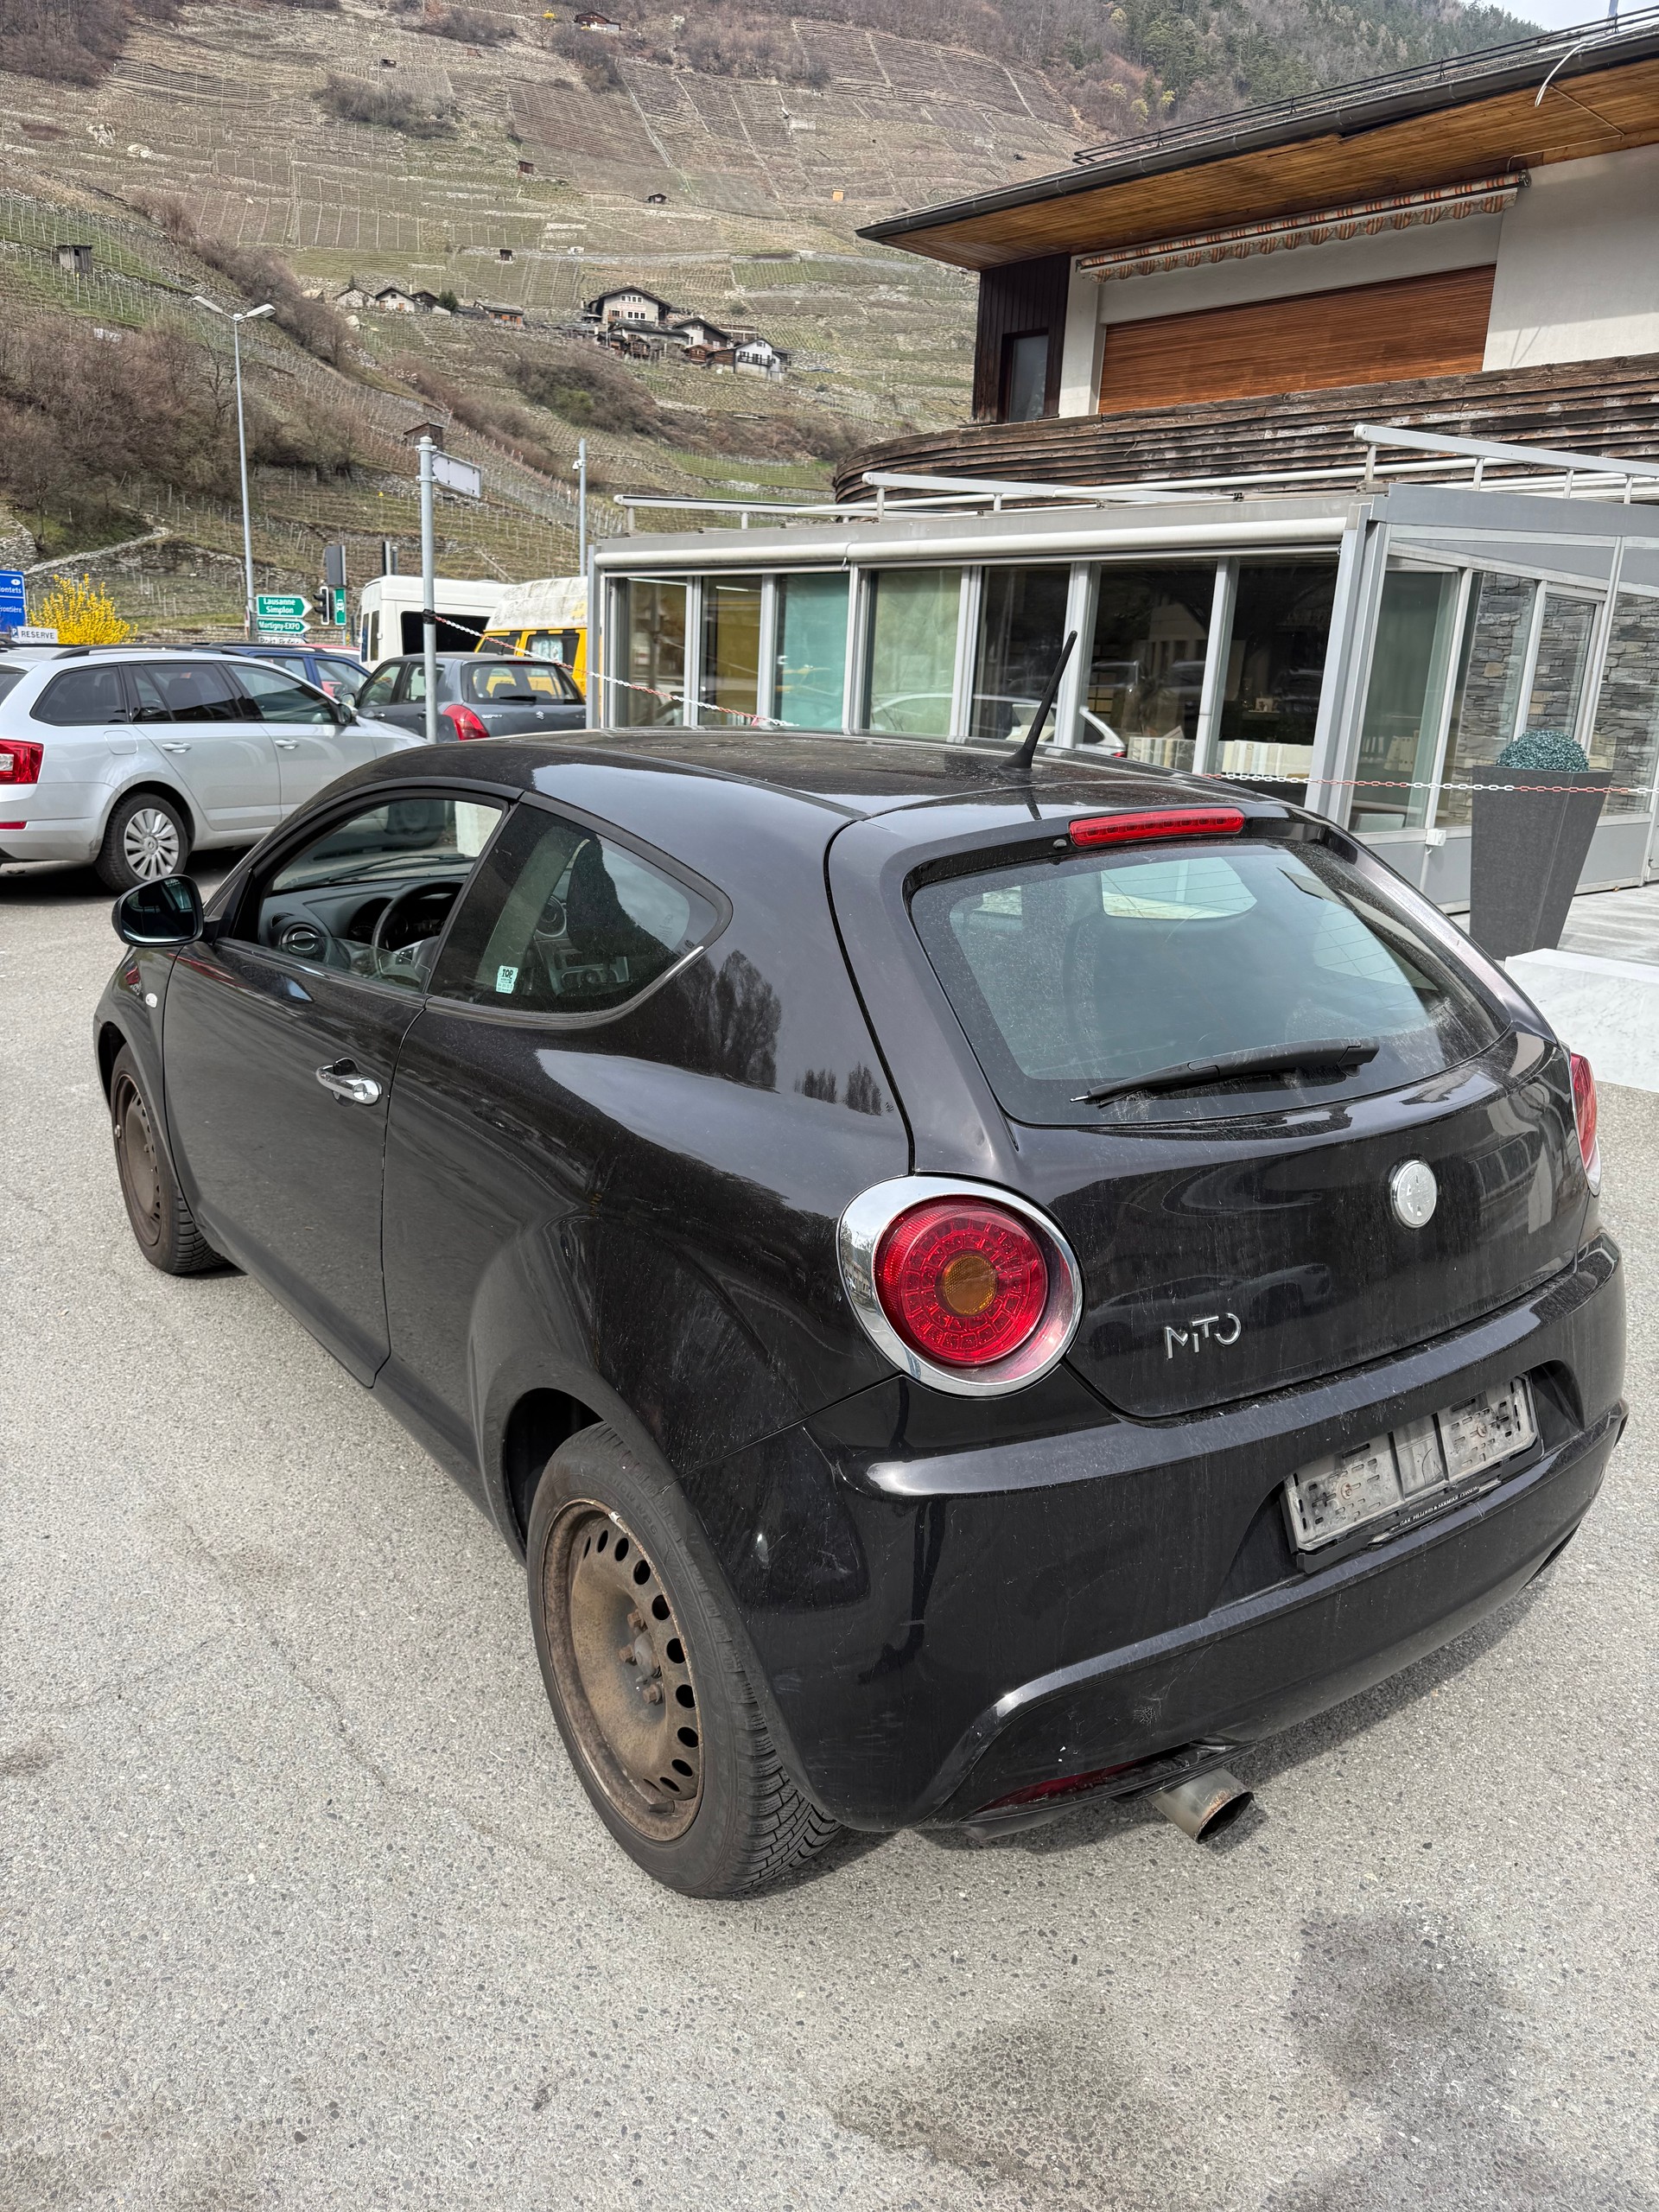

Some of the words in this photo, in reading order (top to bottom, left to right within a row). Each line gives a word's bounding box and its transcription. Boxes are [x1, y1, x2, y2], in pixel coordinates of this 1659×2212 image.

[266, 606, 294, 614] Simplon
[258, 620, 300, 631] Martigny-EXPO
[21, 631, 54, 639] RESERVE
